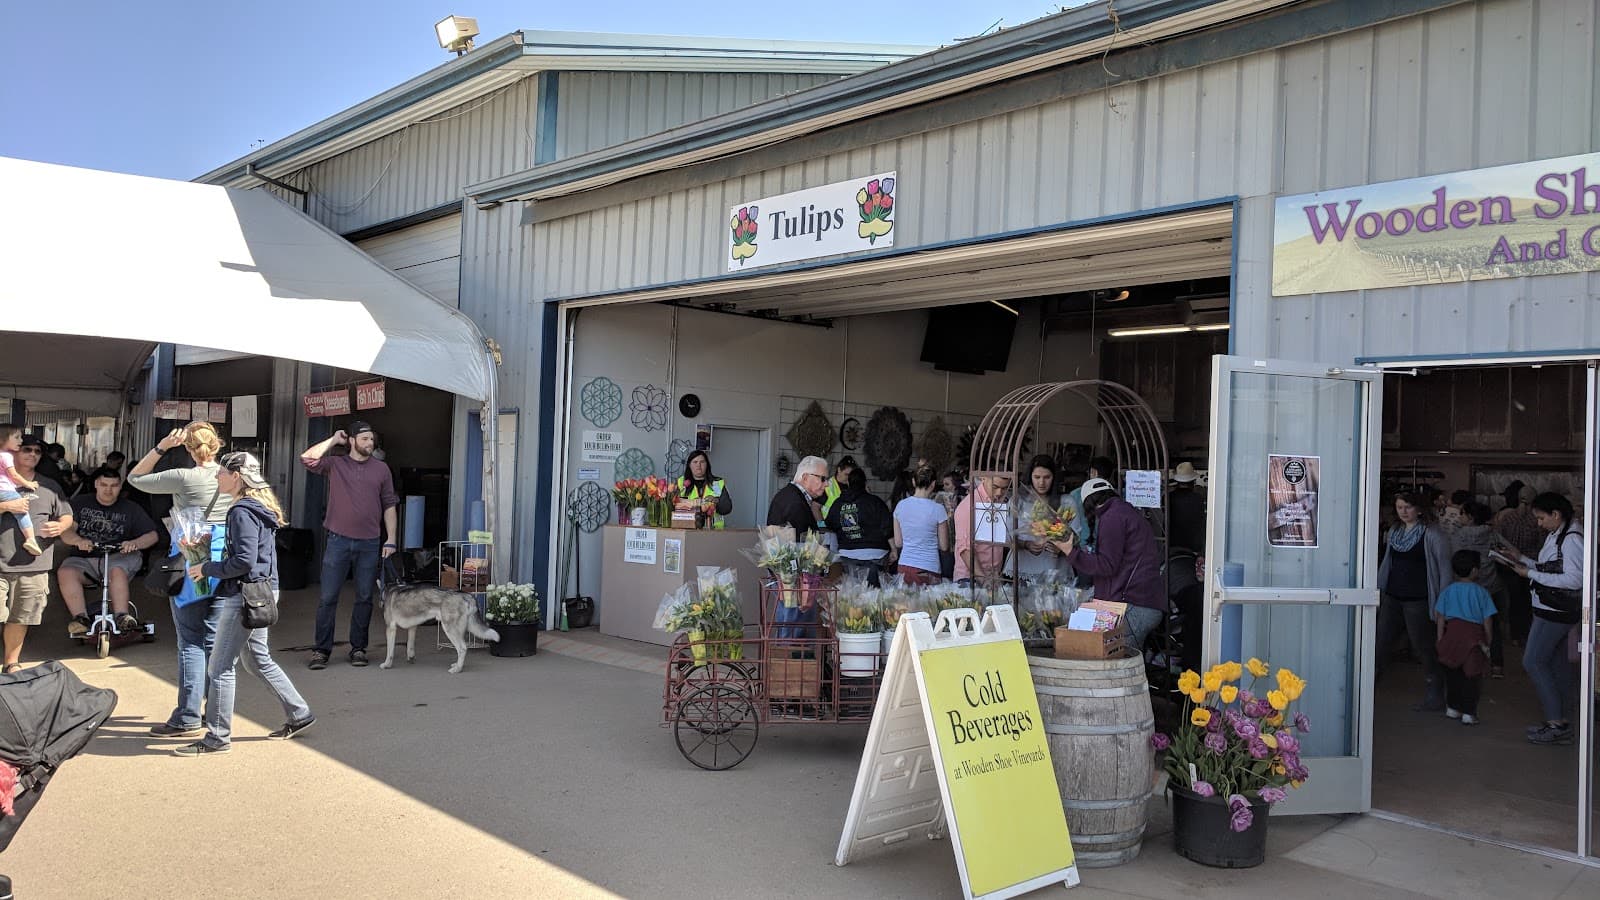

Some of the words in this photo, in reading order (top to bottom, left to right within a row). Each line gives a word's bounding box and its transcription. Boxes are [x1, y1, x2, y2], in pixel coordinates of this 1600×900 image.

[768, 204, 845, 242] Tulips
[1303, 186, 1516, 244] Wooden
[1486, 228, 1569, 266] And
[963, 669, 1008, 708] Cold
[946, 708, 1034, 745] Beverages
[953, 767, 962, 780] at
[962, 757, 994, 776] Wooden
[994, 752, 1012, 771] Shoe
[1012, 745, 1046, 768] Vineyards
